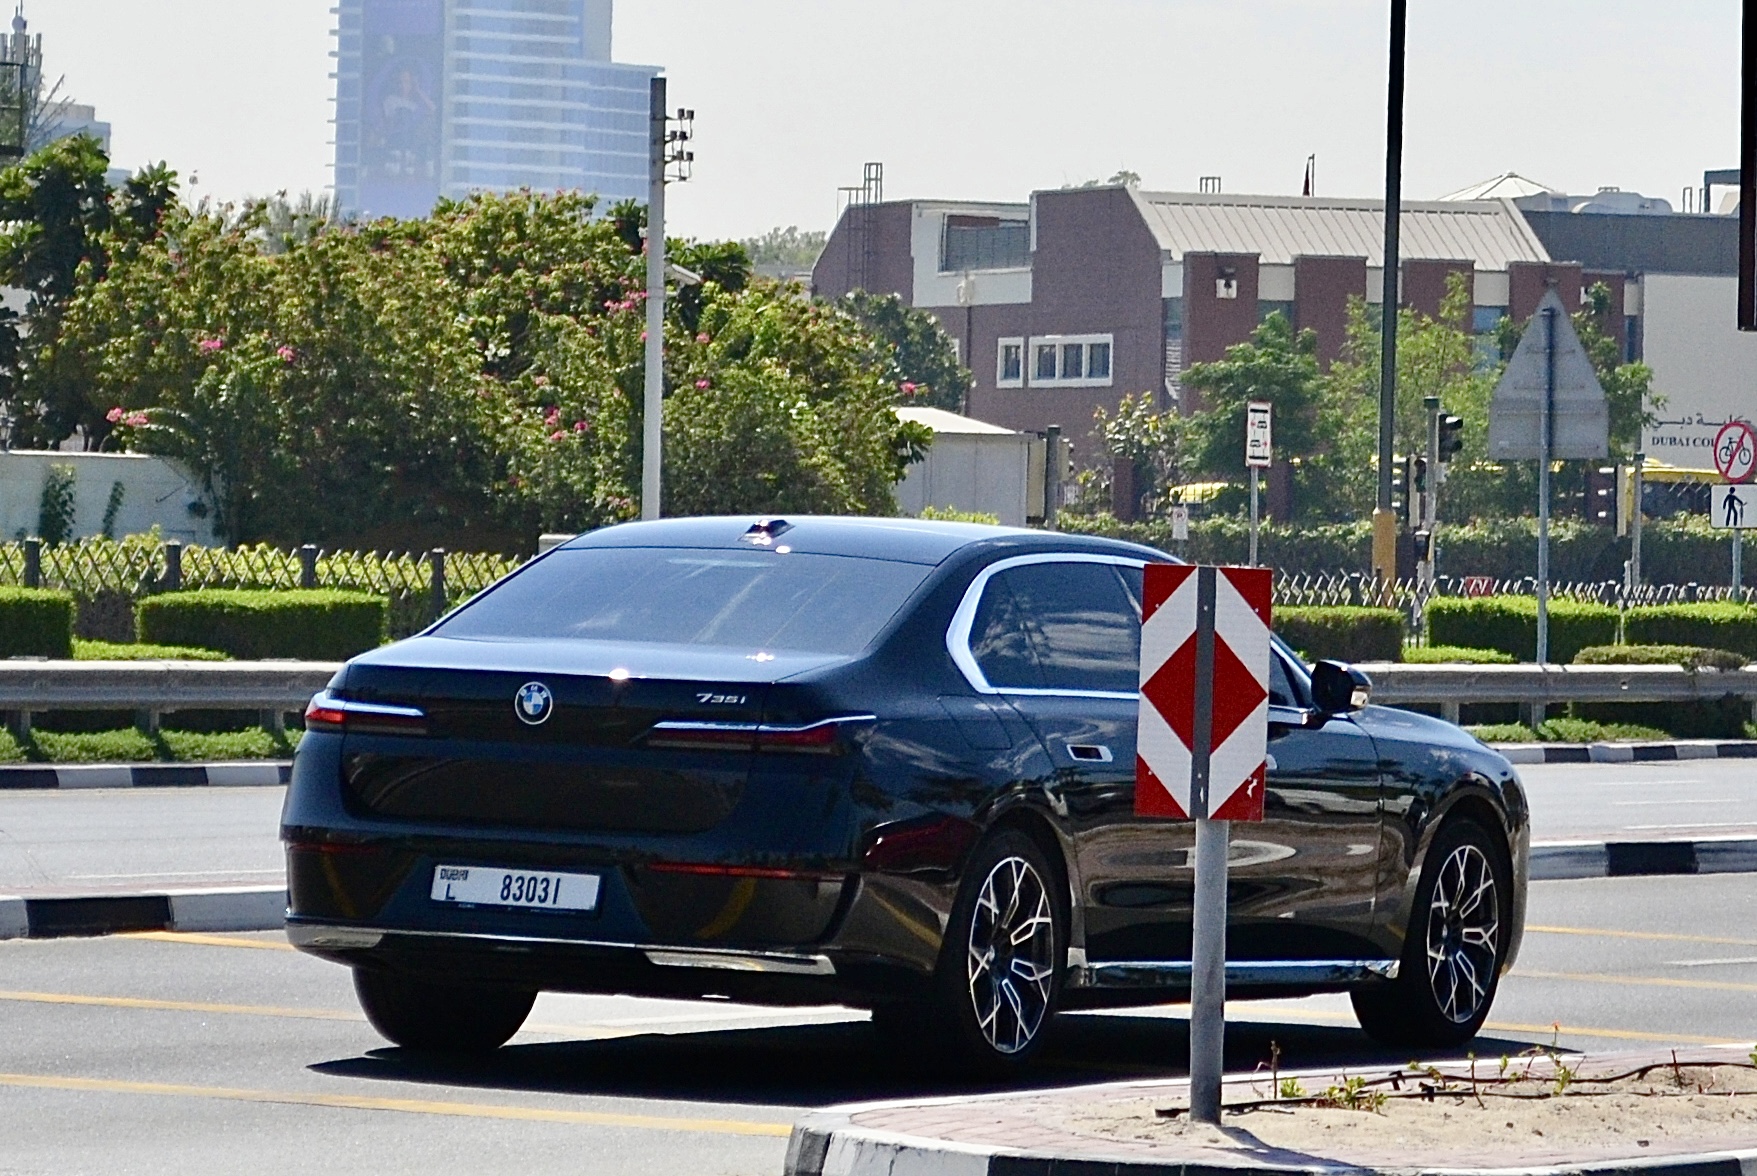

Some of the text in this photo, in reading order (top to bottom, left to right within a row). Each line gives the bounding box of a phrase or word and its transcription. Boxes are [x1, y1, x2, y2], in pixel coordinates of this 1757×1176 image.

[1652, 415, 1693, 431] دبي
[1651, 436, 1689, 447] DUBAI
[696, 692, 746, 705] 735i
[445, 874, 561, 905] L 83031
